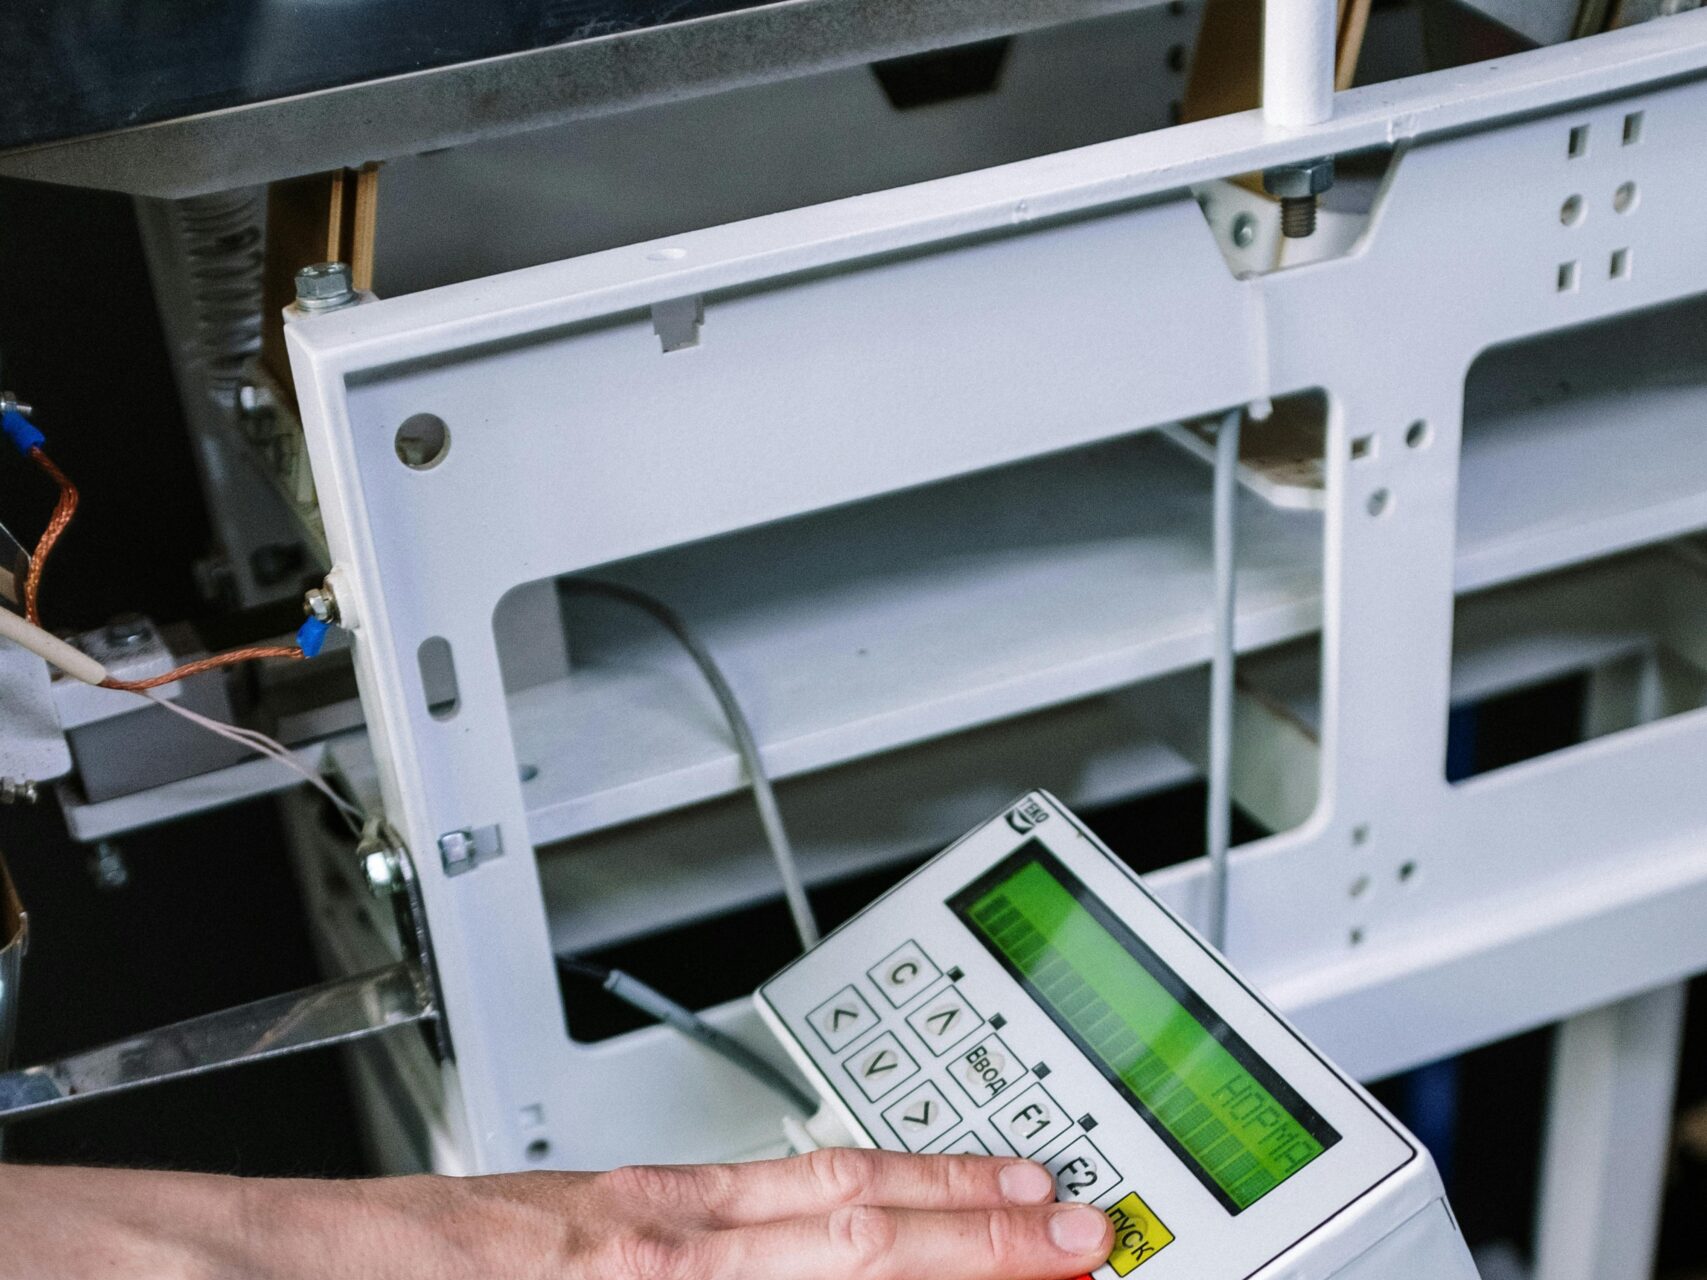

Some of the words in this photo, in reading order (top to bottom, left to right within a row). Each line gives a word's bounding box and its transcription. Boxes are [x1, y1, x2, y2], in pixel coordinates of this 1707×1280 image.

[1011, 1103, 1051, 1139] F1
[1210, 1074, 1314, 1173] НОРМА
[1056, 1156, 1098, 1197] F2
[1108, 1208, 1154, 1261] ПУСК
